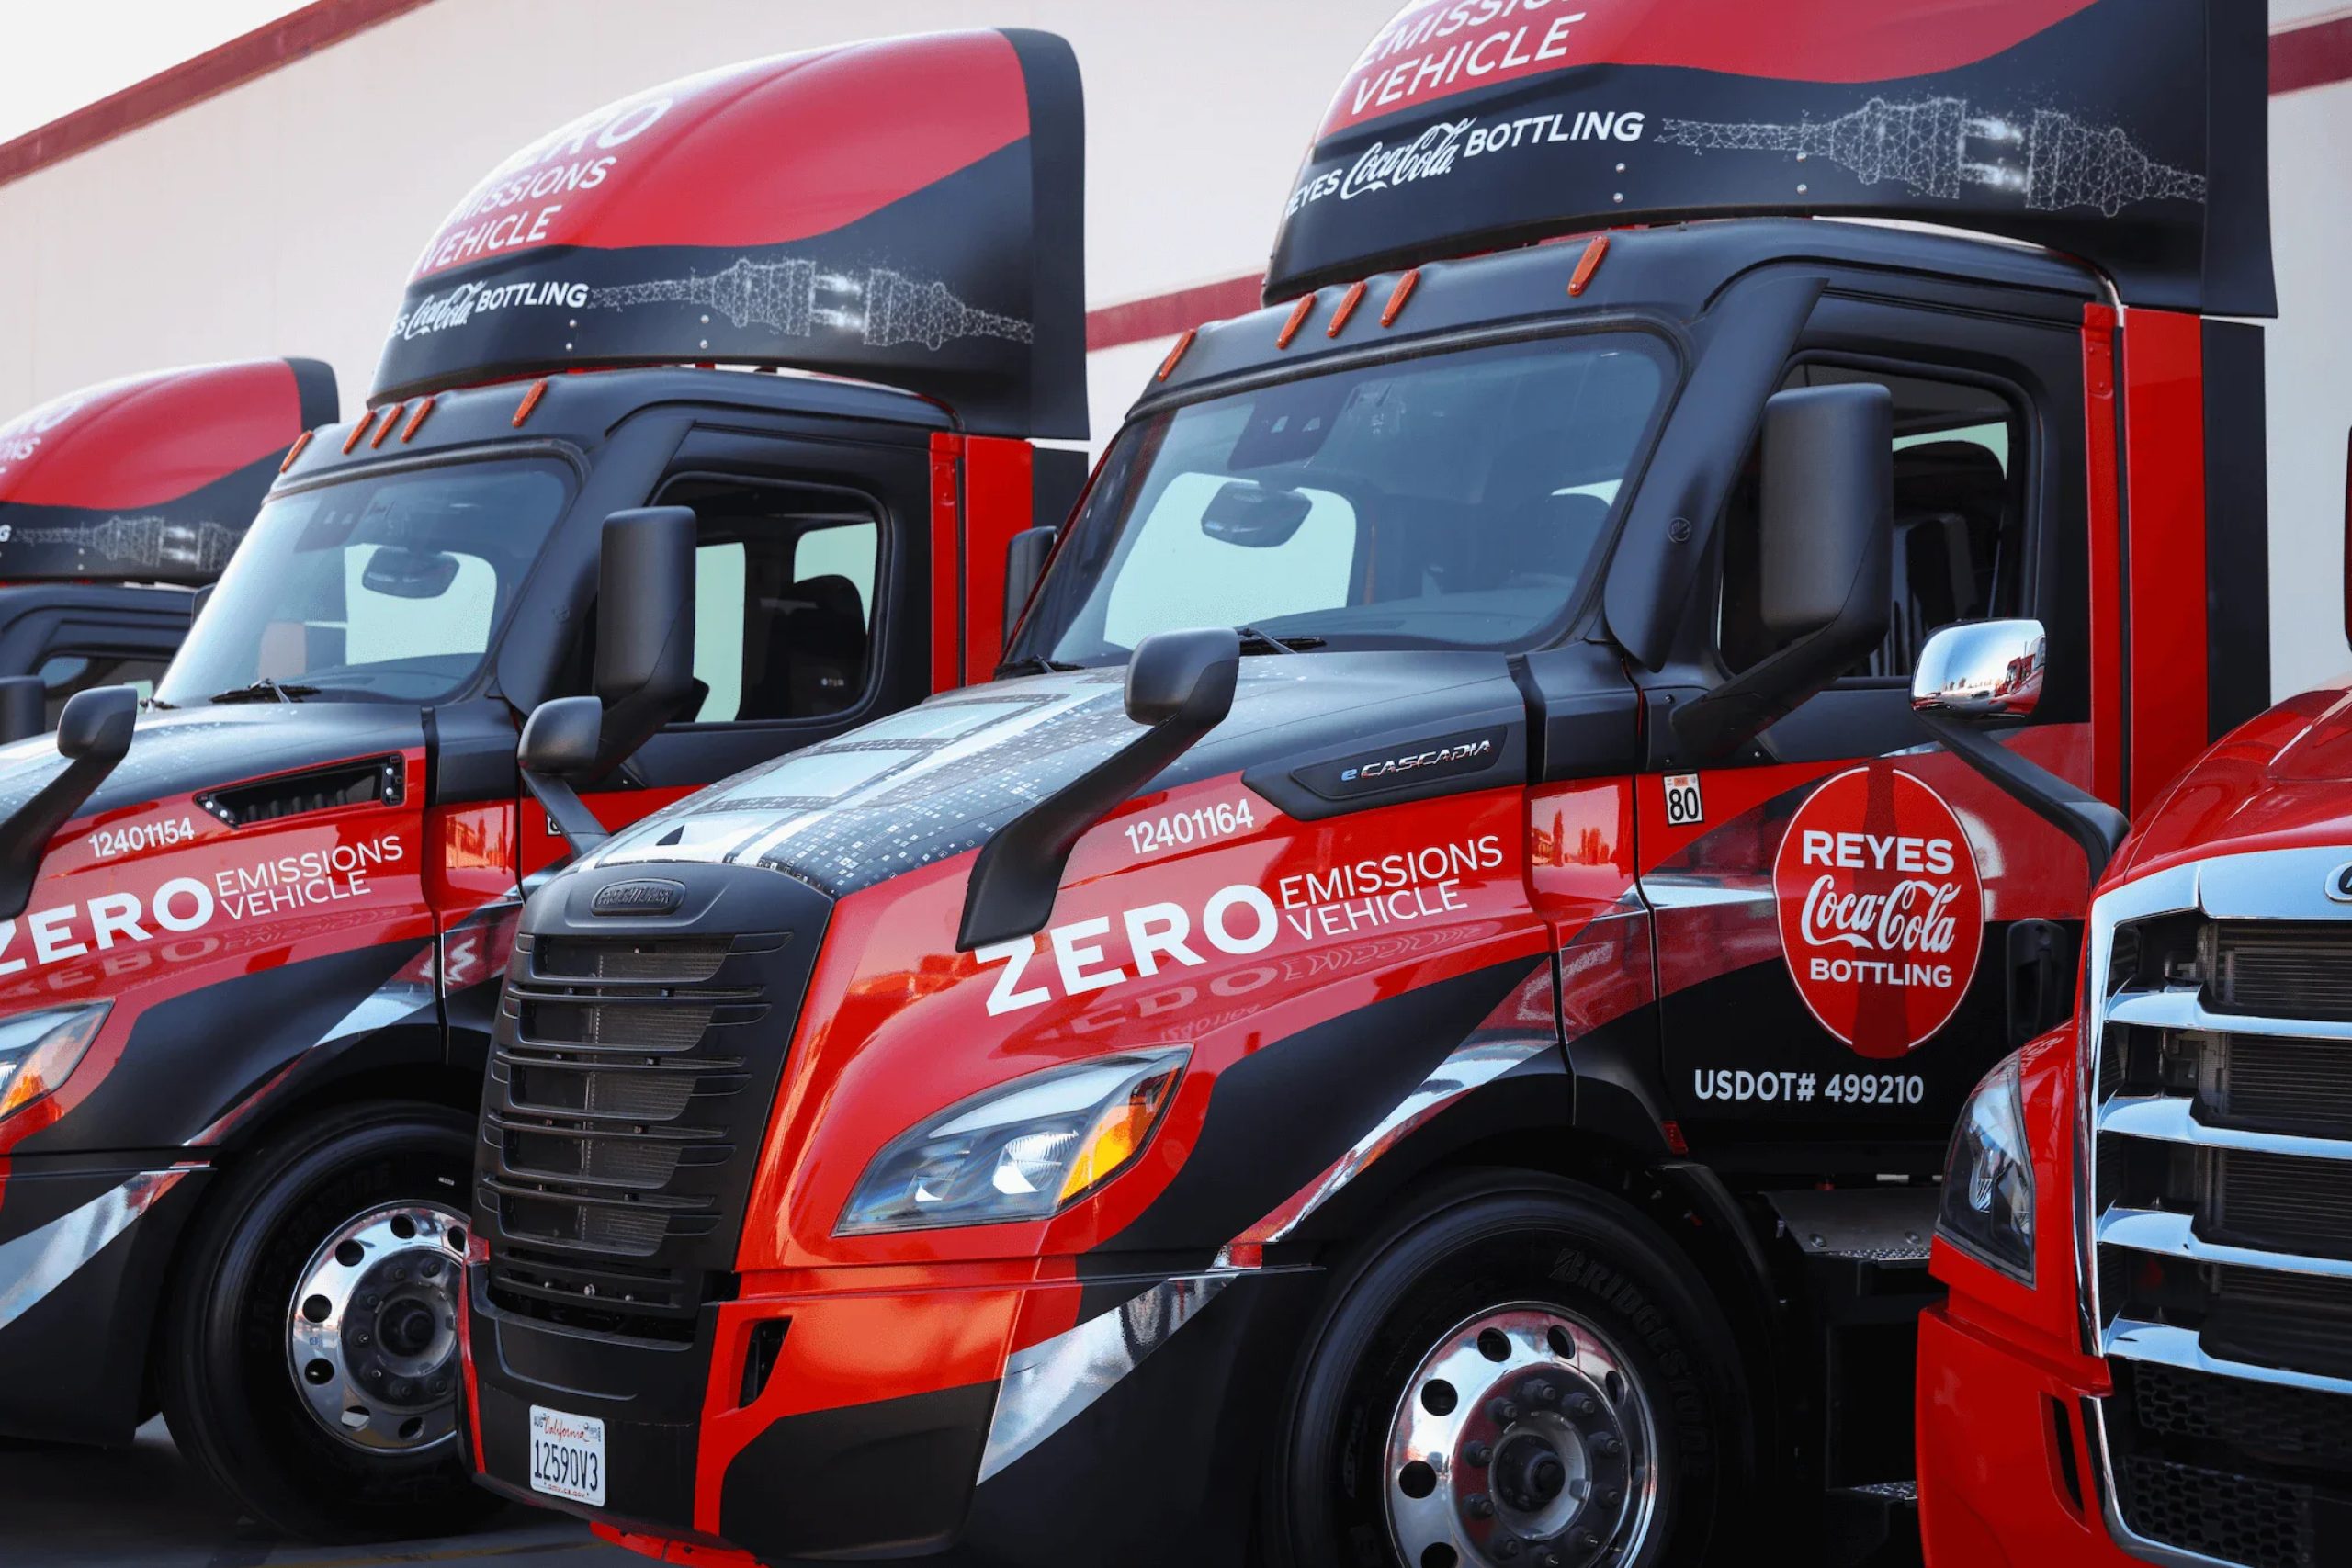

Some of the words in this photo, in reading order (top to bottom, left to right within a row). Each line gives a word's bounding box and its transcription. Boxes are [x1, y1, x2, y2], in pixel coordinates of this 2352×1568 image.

[1351, 12, 1587, 115] VEHICLE
[1286, 168, 1343, 220] EYES
[1340, 116, 1478, 200] Coca-Cola
[1464, 111, 1646, 159] BOTTLING
[422, 204, 562, 273] VEHICLE
[475, 281, 589, 313] BOTTLING
[1124, 798, 1255, 855] 12401164
[1668, 786, 1700, 822] 80
[88, 817, 195, 858] 12401154
[215, 835, 404, 897] EMISSIONS
[1802, 829, 1955, 875] REYES
[220, 869, 371, 920] VEHICLE
[1279, 835, 1504, 911] EMISSIONS
[1286, 878, 1468, 941] VEHICLE
[1800, 874, 1962, 953] Coca-Cola
[974, 884, 1280, 1017] ZERO
[1809, 958, 1953, 988] BOTTLING
[1694, 1068, 1816, 1103] USDOT#
[1824, 1073, 1925, 1104] 499210
[534, 1438, 598, 1493] 12590V3
